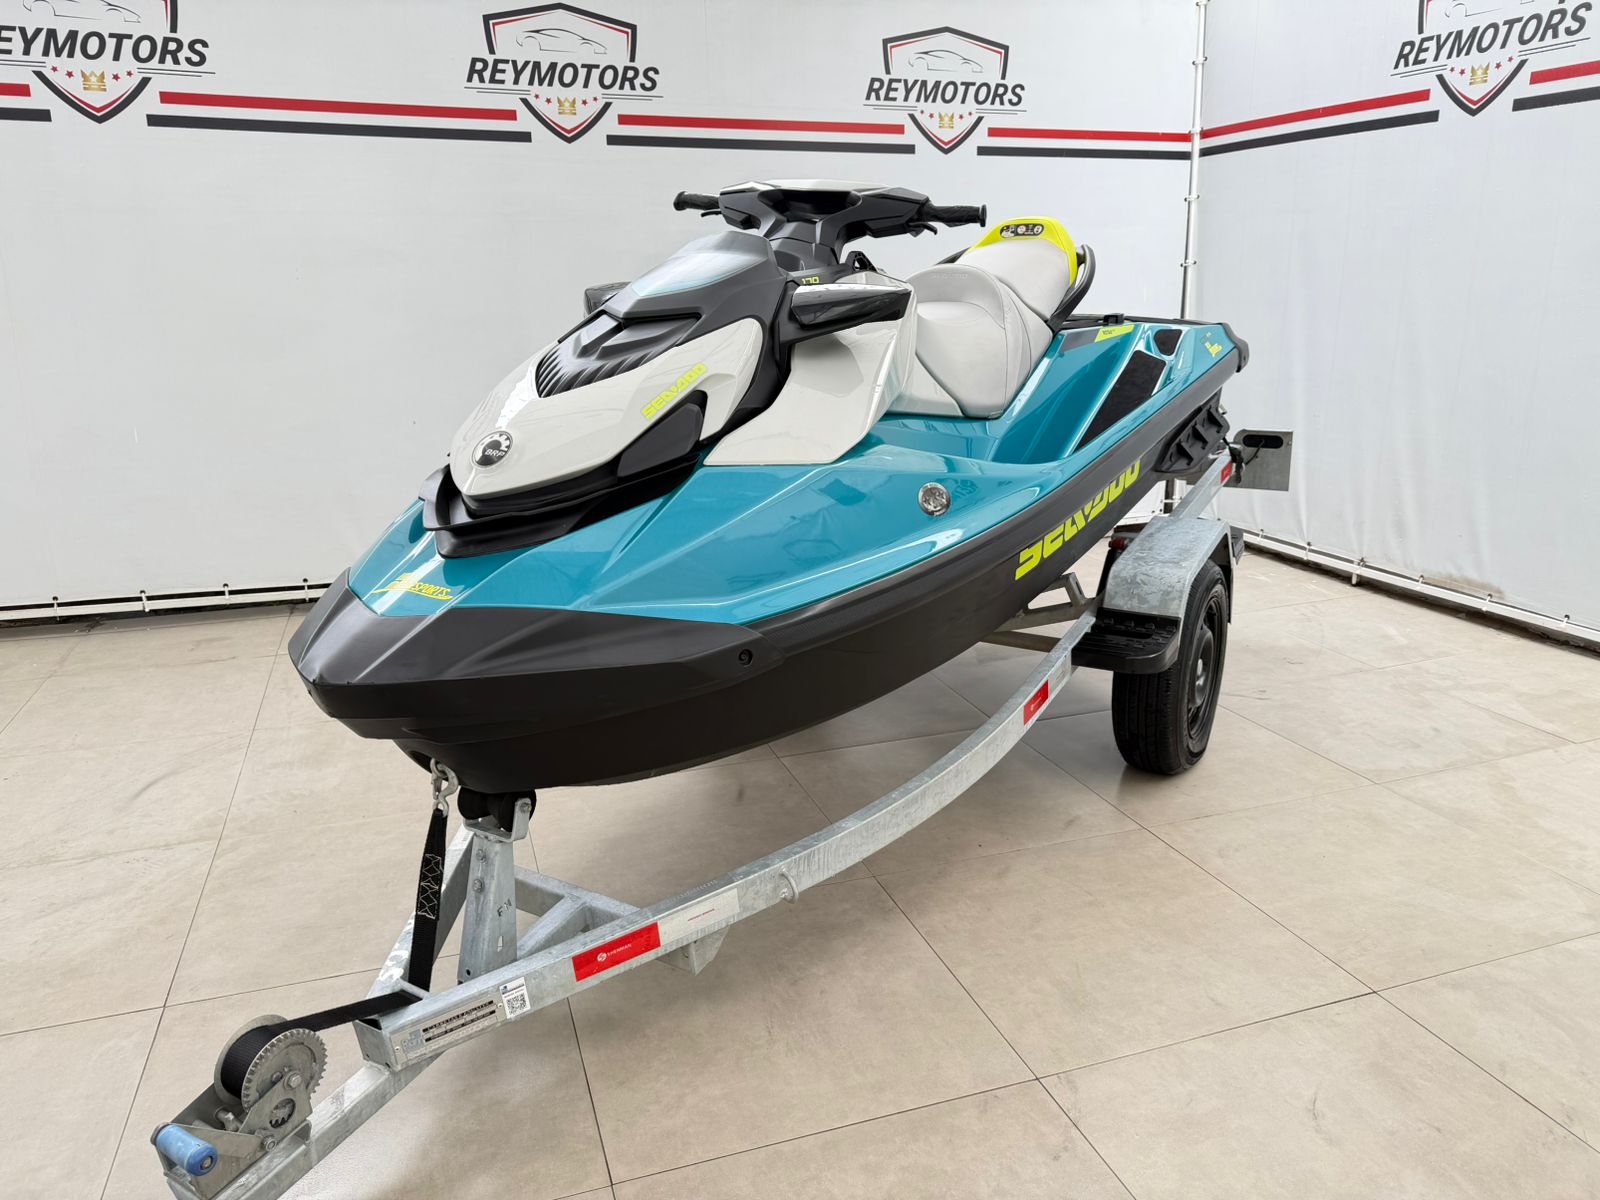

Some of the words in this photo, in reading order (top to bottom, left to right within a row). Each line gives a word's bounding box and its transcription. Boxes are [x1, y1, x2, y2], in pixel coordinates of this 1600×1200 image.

[0, 24, 210, 68] EYMOTORS
[1393, 2, 1593, 70] REYMOTORS
[466, 57, 660, 92] REYMOTORS
[865, 77, 1026, 107] REYMOTORS
[801, 276, 820, 285] 170
[484, 448, 506, 457] BRP
